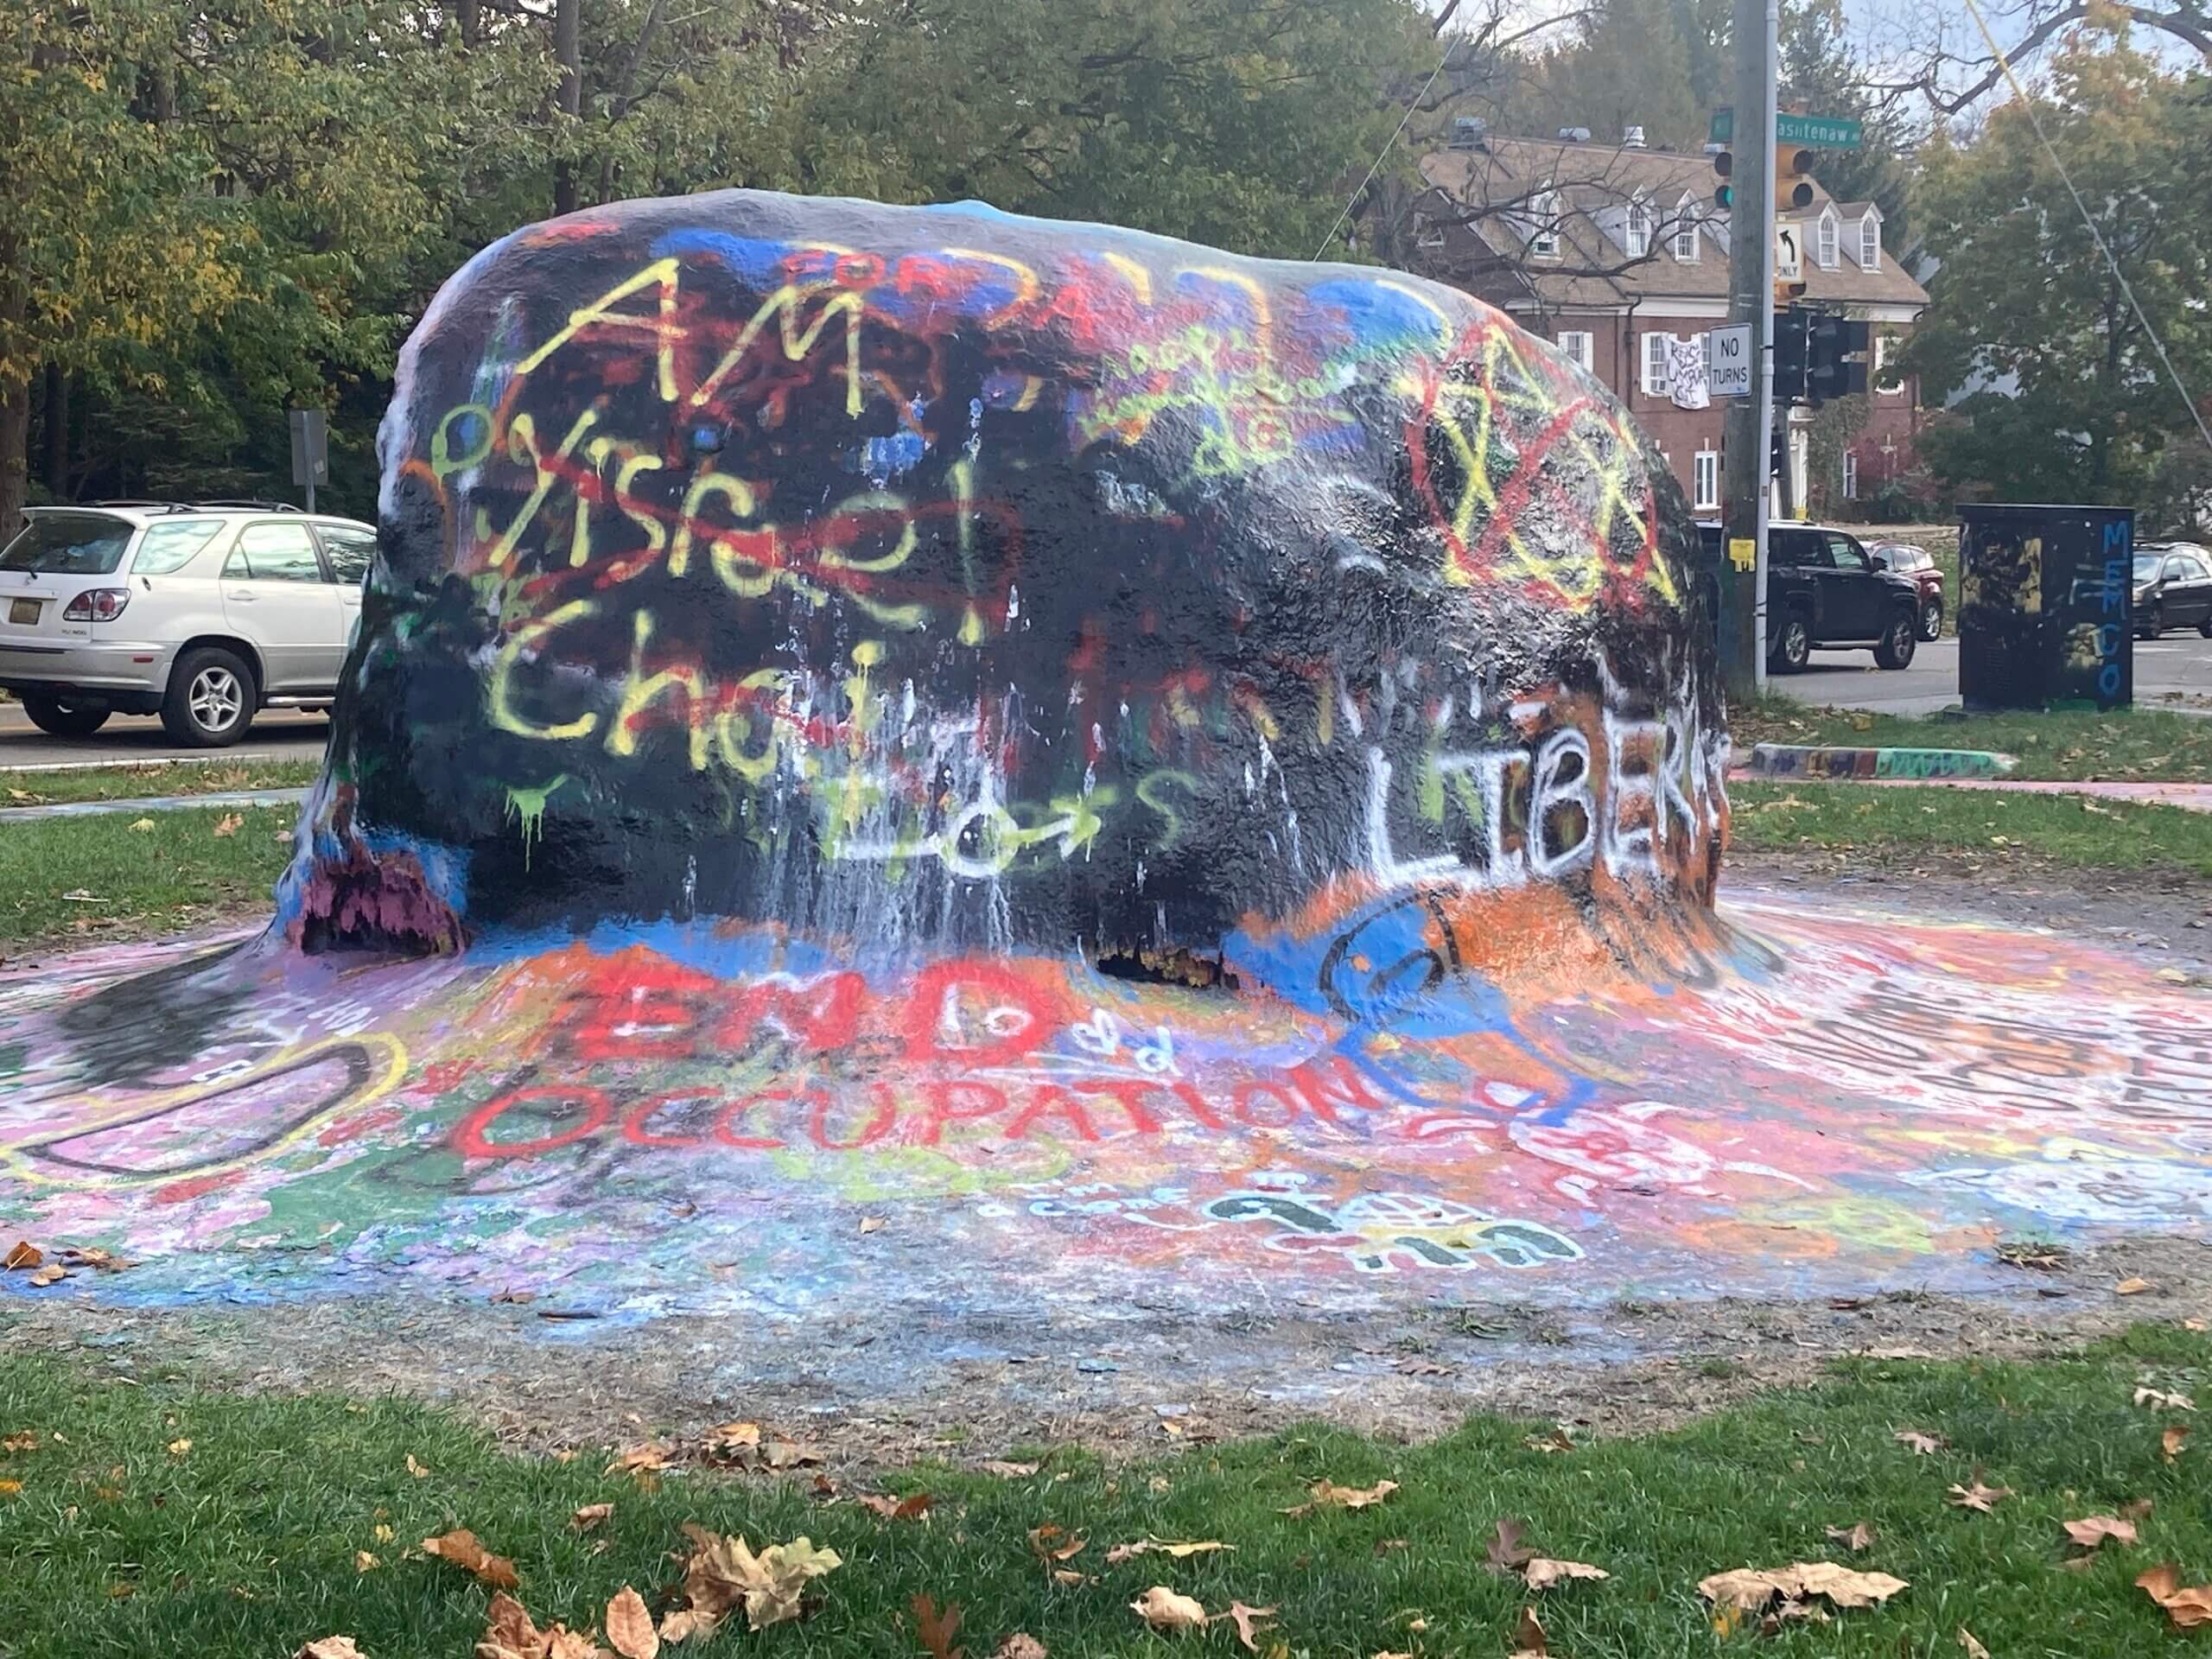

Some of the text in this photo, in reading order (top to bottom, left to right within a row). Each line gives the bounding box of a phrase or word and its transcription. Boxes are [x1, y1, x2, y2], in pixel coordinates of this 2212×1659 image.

[1777, 124, 1848, 142] ashtenaw
[516, 258, 868, 421] AM
[1721, 338, 1738, 357] NO
[1713, 367, 1747, 385] TURNS
[572, 957, 1056, 1066] END
[452, 1054, 1384, 1159] OCCUPATION
